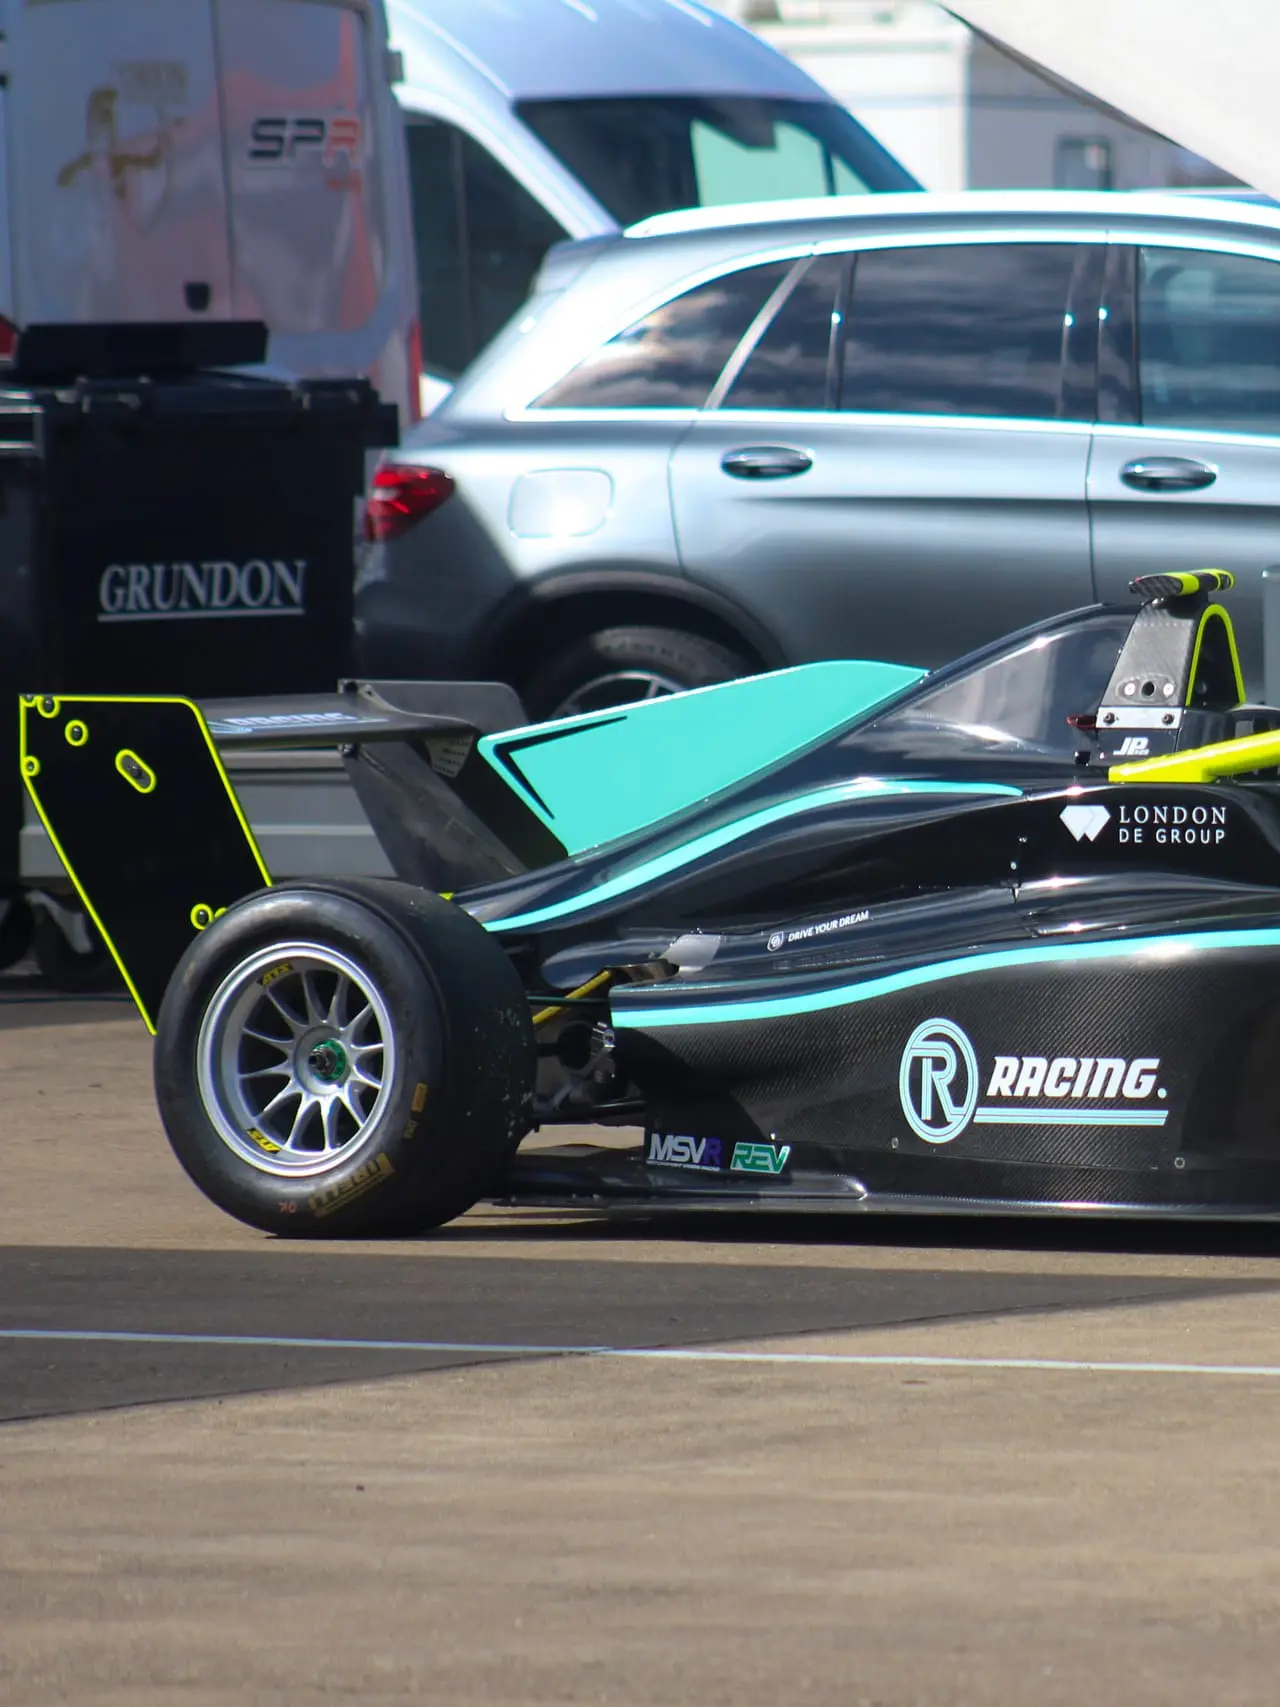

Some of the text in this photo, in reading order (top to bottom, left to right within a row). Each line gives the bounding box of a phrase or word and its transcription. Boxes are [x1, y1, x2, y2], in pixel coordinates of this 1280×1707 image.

[100, 559, 307, 613] GRUNDON
[1119, 805, 1227, 824] LONDON
[1119, 828, 1226, 844] DE GROUP
[788, 910, 869, 942] DRIVE YOUR DREAM
[648, 1132, 723, 1165] MSVR
[731, 1142, 790, 1174] REV
